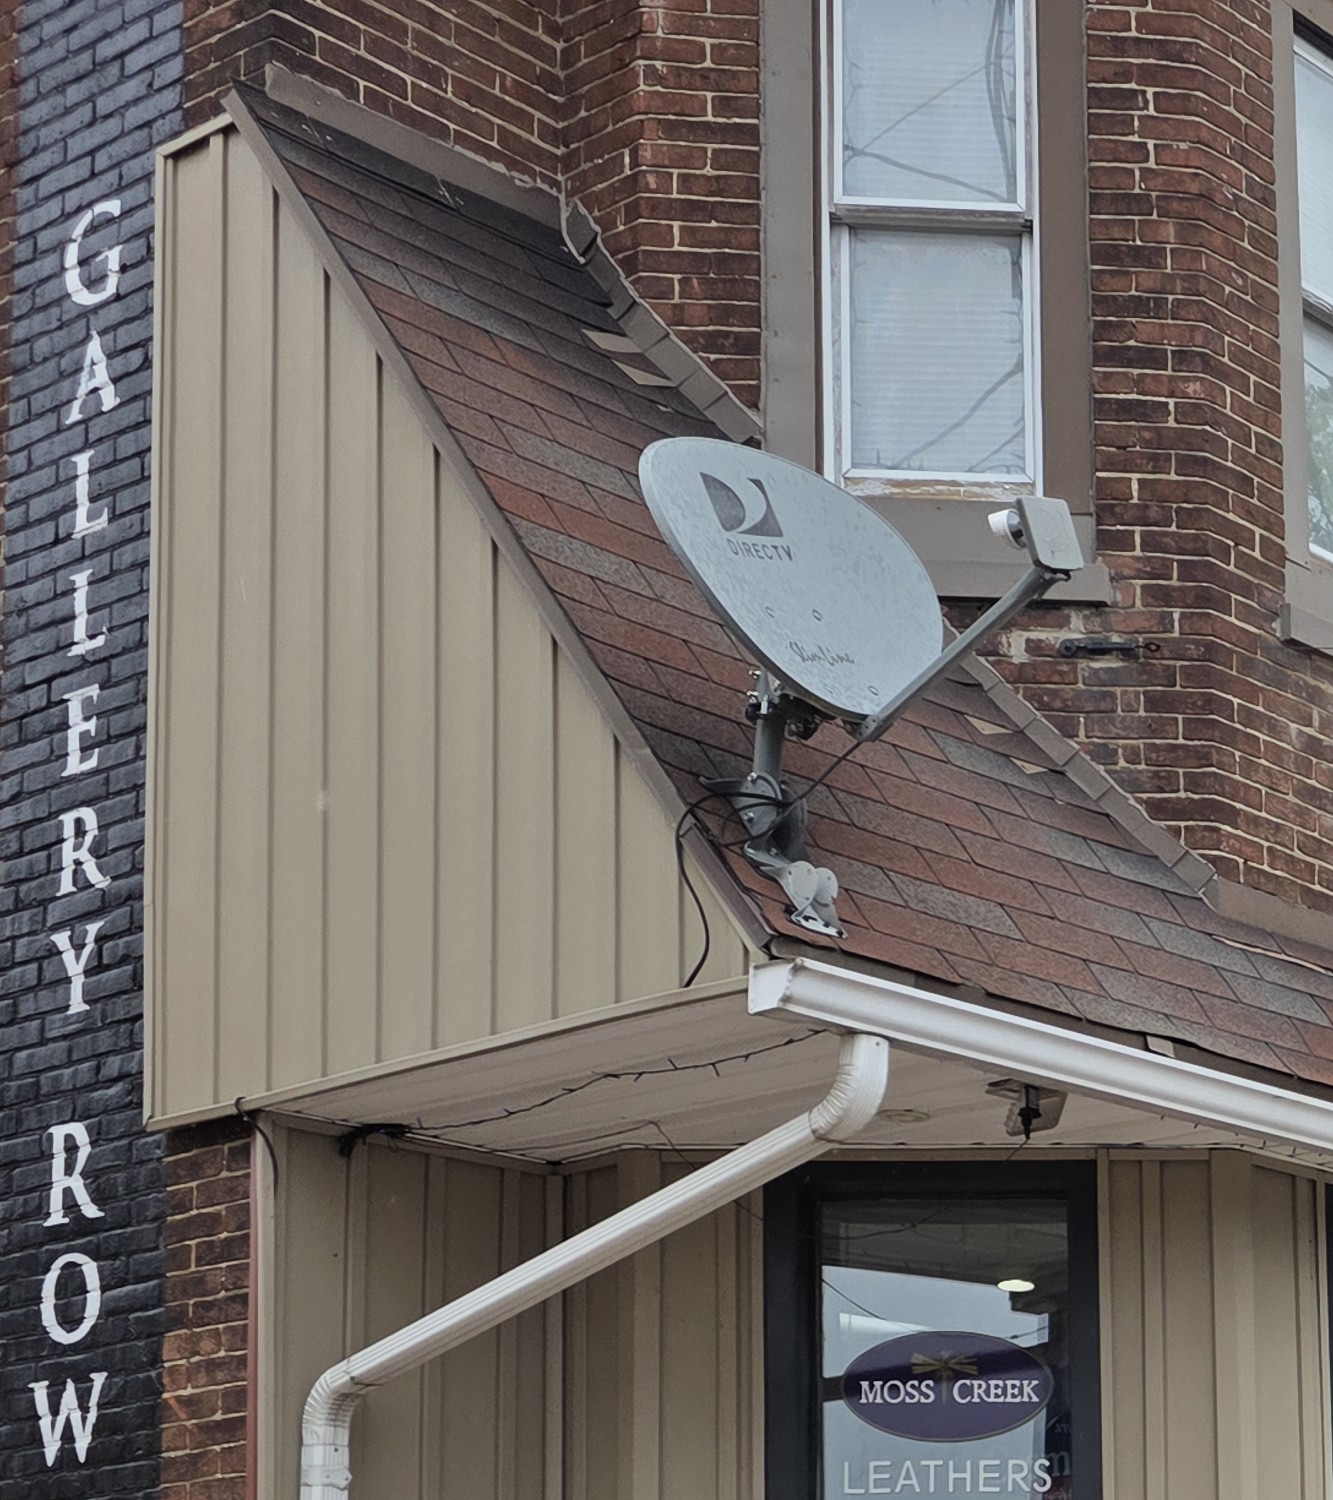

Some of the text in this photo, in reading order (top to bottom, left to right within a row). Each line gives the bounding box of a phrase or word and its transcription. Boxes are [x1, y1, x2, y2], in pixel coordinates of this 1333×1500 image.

[726, 538, 793, 562] DIRECTV
[50, 200, 122, 1014] GALLERY
[27, 1121, 106, 1467] ROW
[859, 1379, 1040, 1403] MOSS CREEK
[843, 1458, 1052, 1494] LEATHERS
